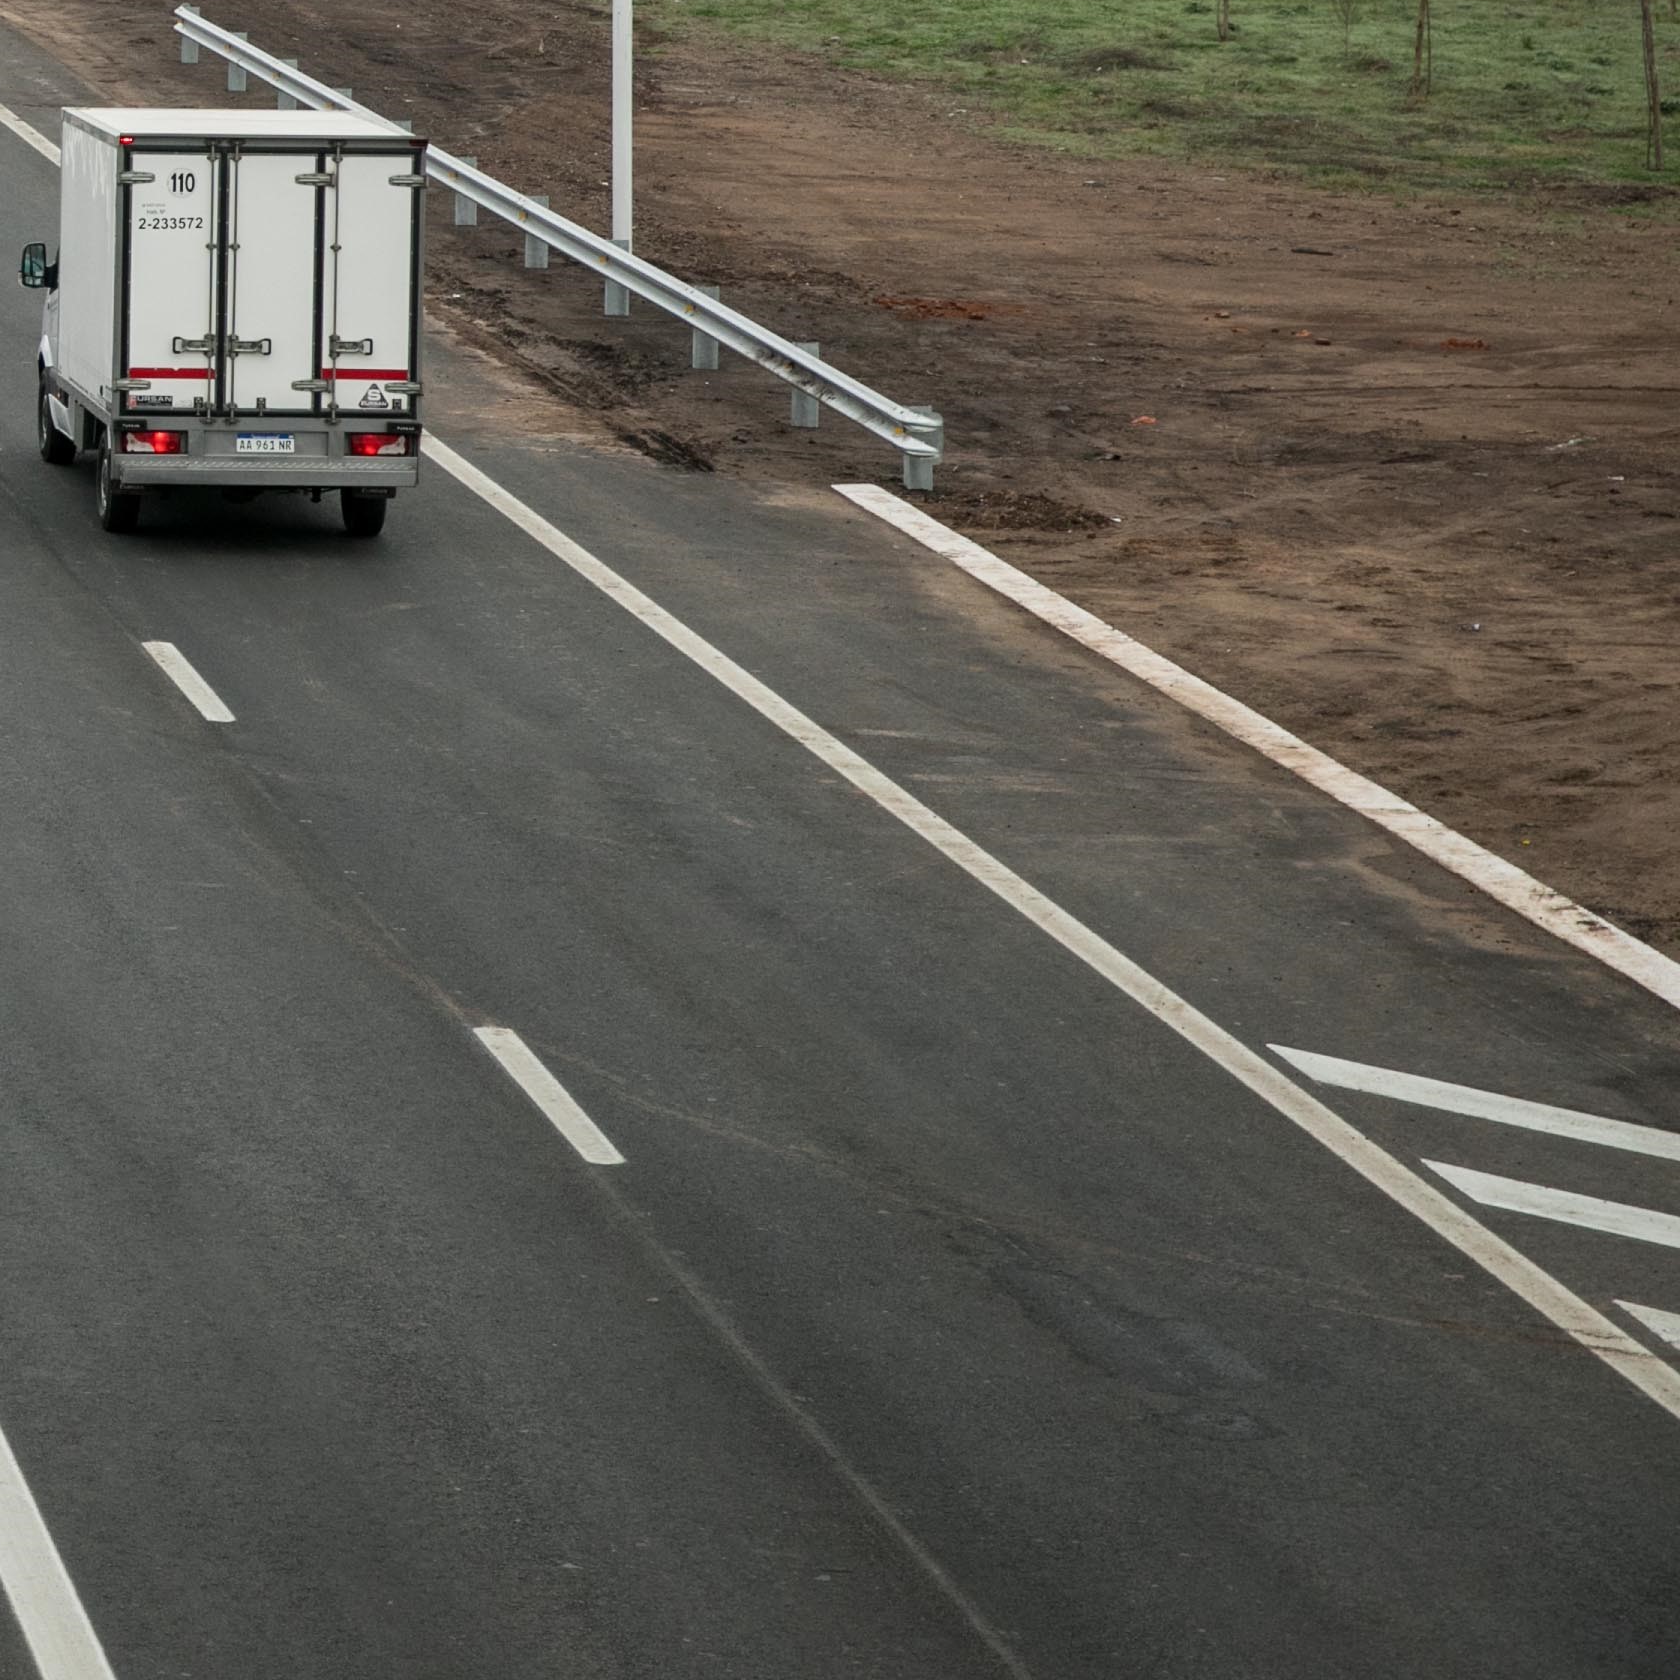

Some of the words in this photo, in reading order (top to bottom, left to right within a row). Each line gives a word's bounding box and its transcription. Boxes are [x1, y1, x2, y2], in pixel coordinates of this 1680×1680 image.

[171, 173, 195, 193] 110
[138, 217, 203, 230] 2-233572
[367, 389, 381, 401] S
[240, 440, 252, 450] AA
[256, 440, 275, 450] 961
